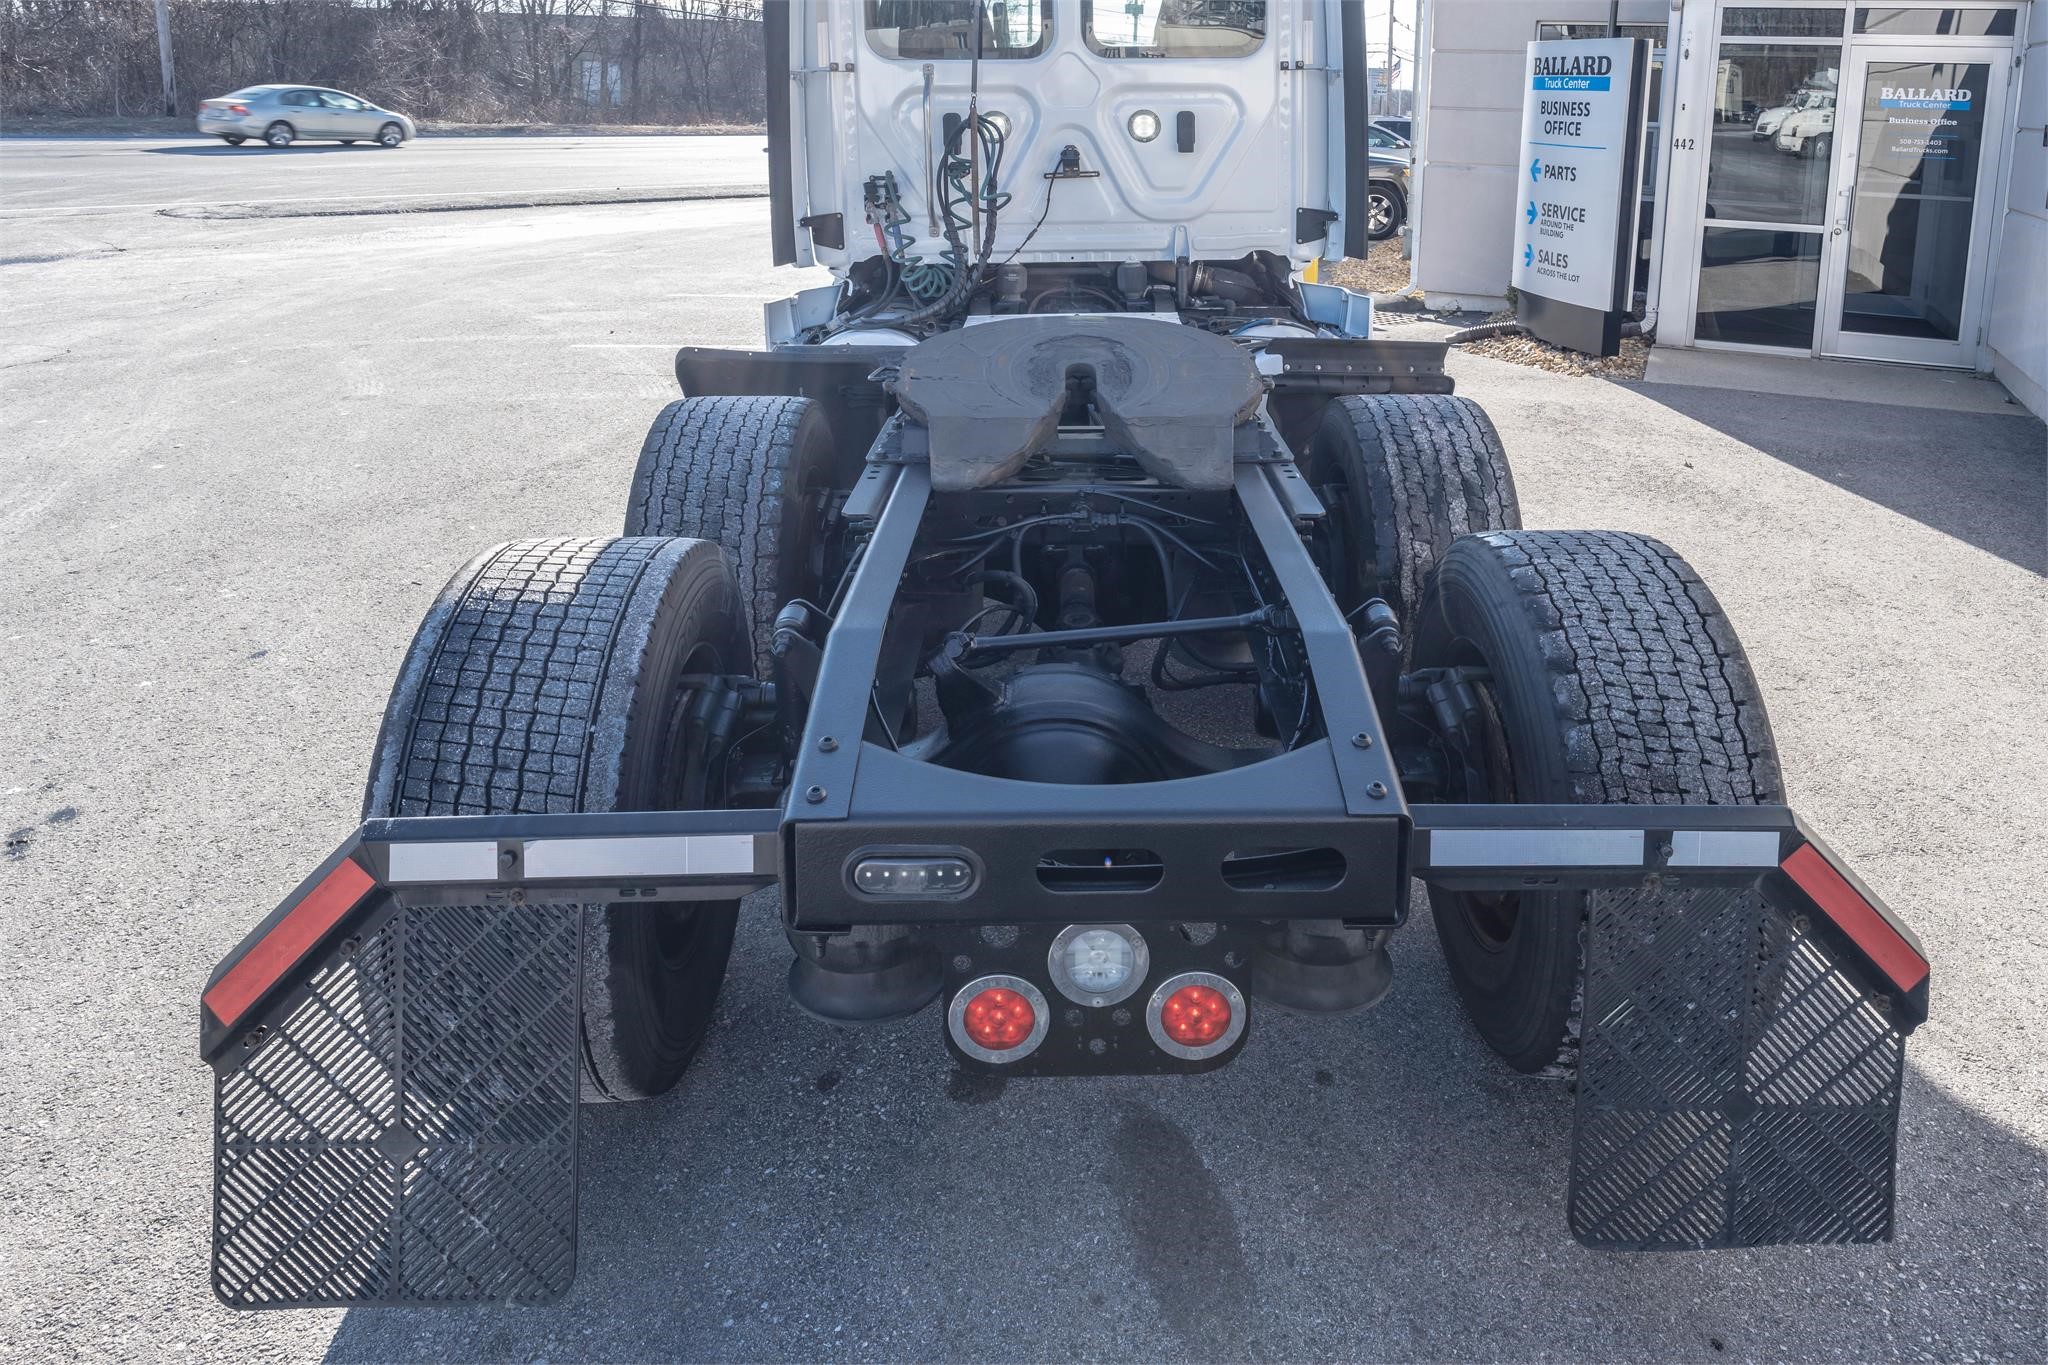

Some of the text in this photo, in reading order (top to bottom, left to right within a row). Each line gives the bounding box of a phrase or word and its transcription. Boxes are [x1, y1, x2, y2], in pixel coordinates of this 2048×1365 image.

[1533, 56, 1612, 75] BALLARD
[1545, 78, 1590, 88] Truck Center
[1880, 87, 1972, 101] BALLARD
[1541, 101, 1590, 117] BUSINESS
[1899, 100, 1951, 109] Truck Center
[1544, 120, 1581, 136] OFFICE
[1889, 117, 1958, 126] Business Office
[1674, 138, 1694, 150] 442
[1544, 164, 1577, 182] PARTS
[1541, 202, 1586, 223] SERVICE
[1540, 218, 1574, 231] AROUND THE
[1540, 227, 1564, 239] BUILDING
[1538, 249, 1568, 269] SALES
[1537, 266, 1580, 283] ACROSS THE LOT
